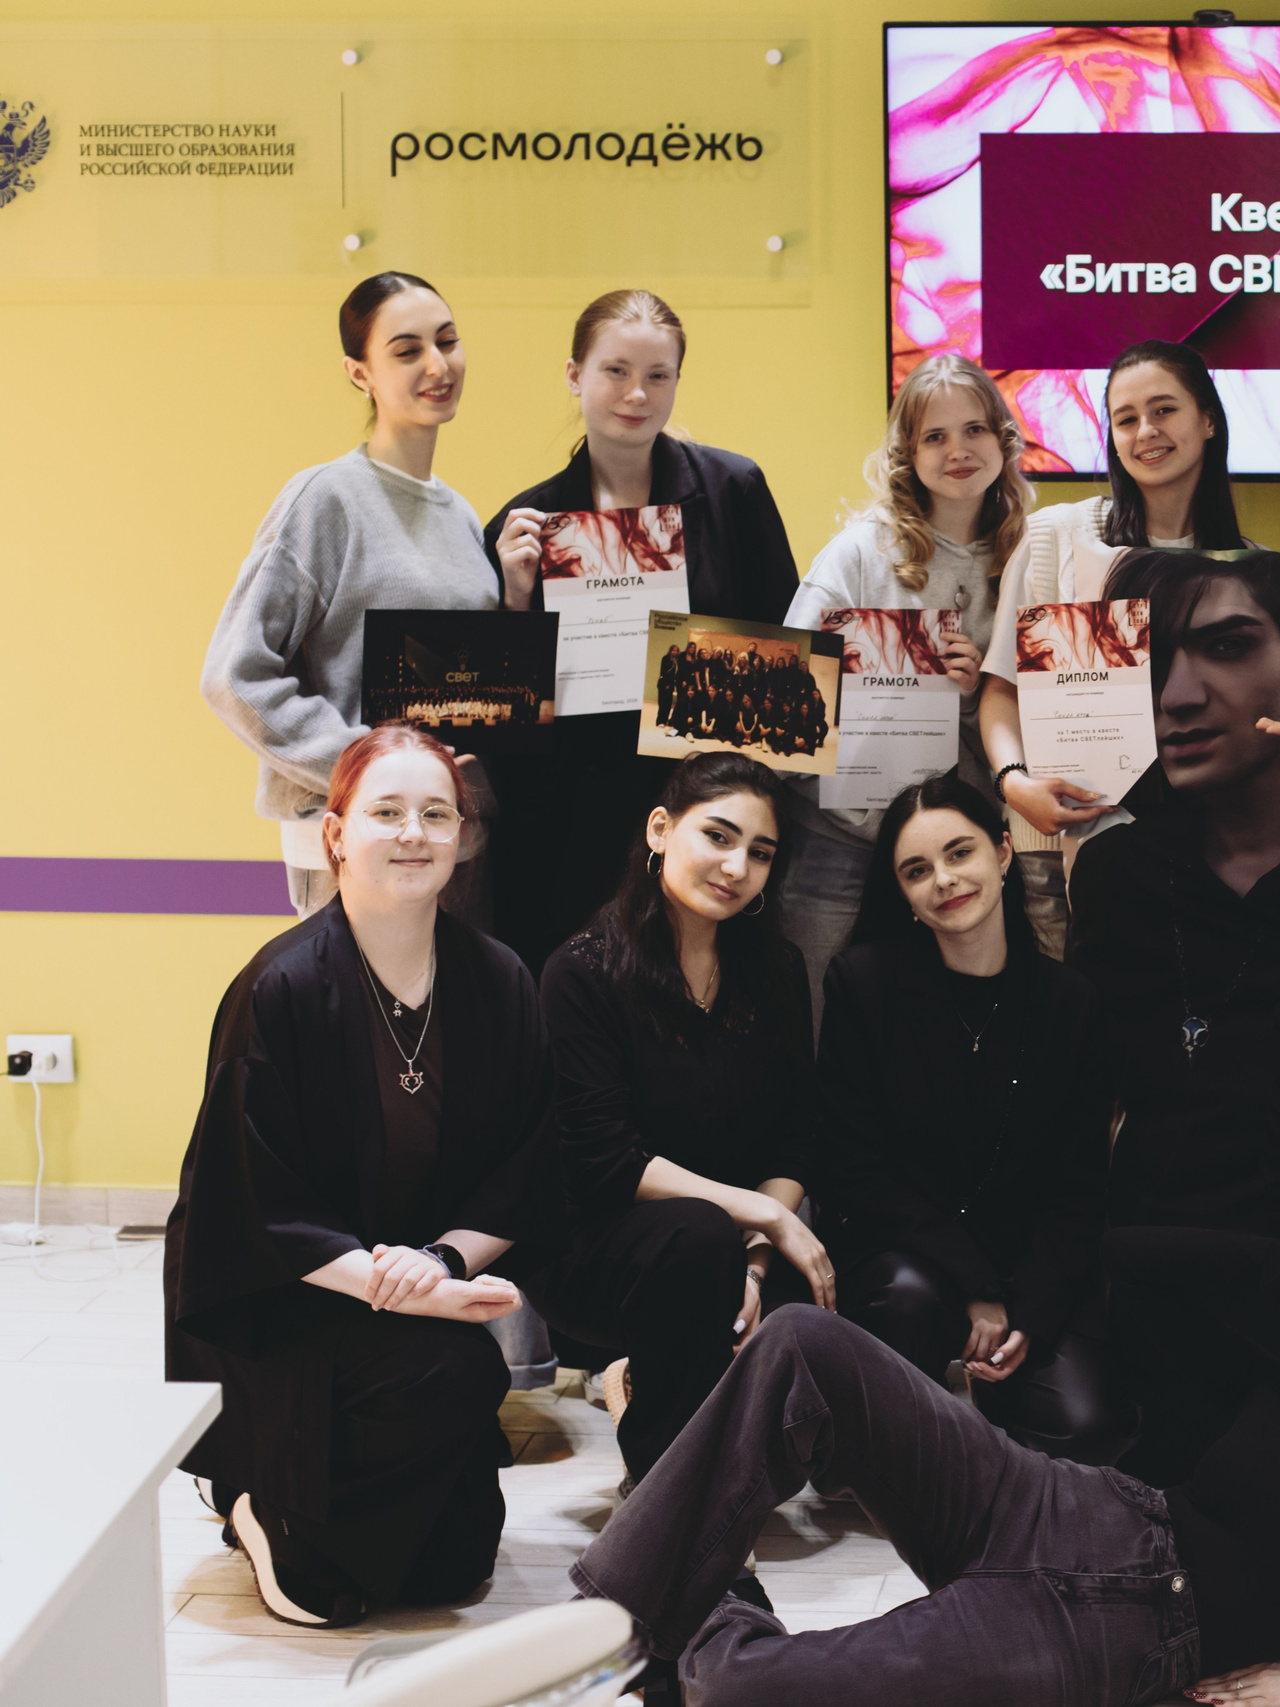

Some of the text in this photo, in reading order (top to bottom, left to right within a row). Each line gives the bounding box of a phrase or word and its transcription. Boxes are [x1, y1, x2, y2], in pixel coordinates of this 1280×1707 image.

[79, 124, 277, 137] МИНИСТЕРСТВО НАУКИ
[79, 143, 295, 156] И ВЫСШЕГО ОБРАЗОВАНИЯ
[391, 123, 763, 177] росмолодёжь
[79, 160, 294, 177] РОССИЙСКОЙ ФЕДЕРАЦИИ
[1039, 254, 1197, 293] «Битва
[586, 576, 645, 589] ГРАМОТА
[863, 677, 919, 687] ГРАМОТА
[1057, 672, 1109, 685] ДИПЛОМ
